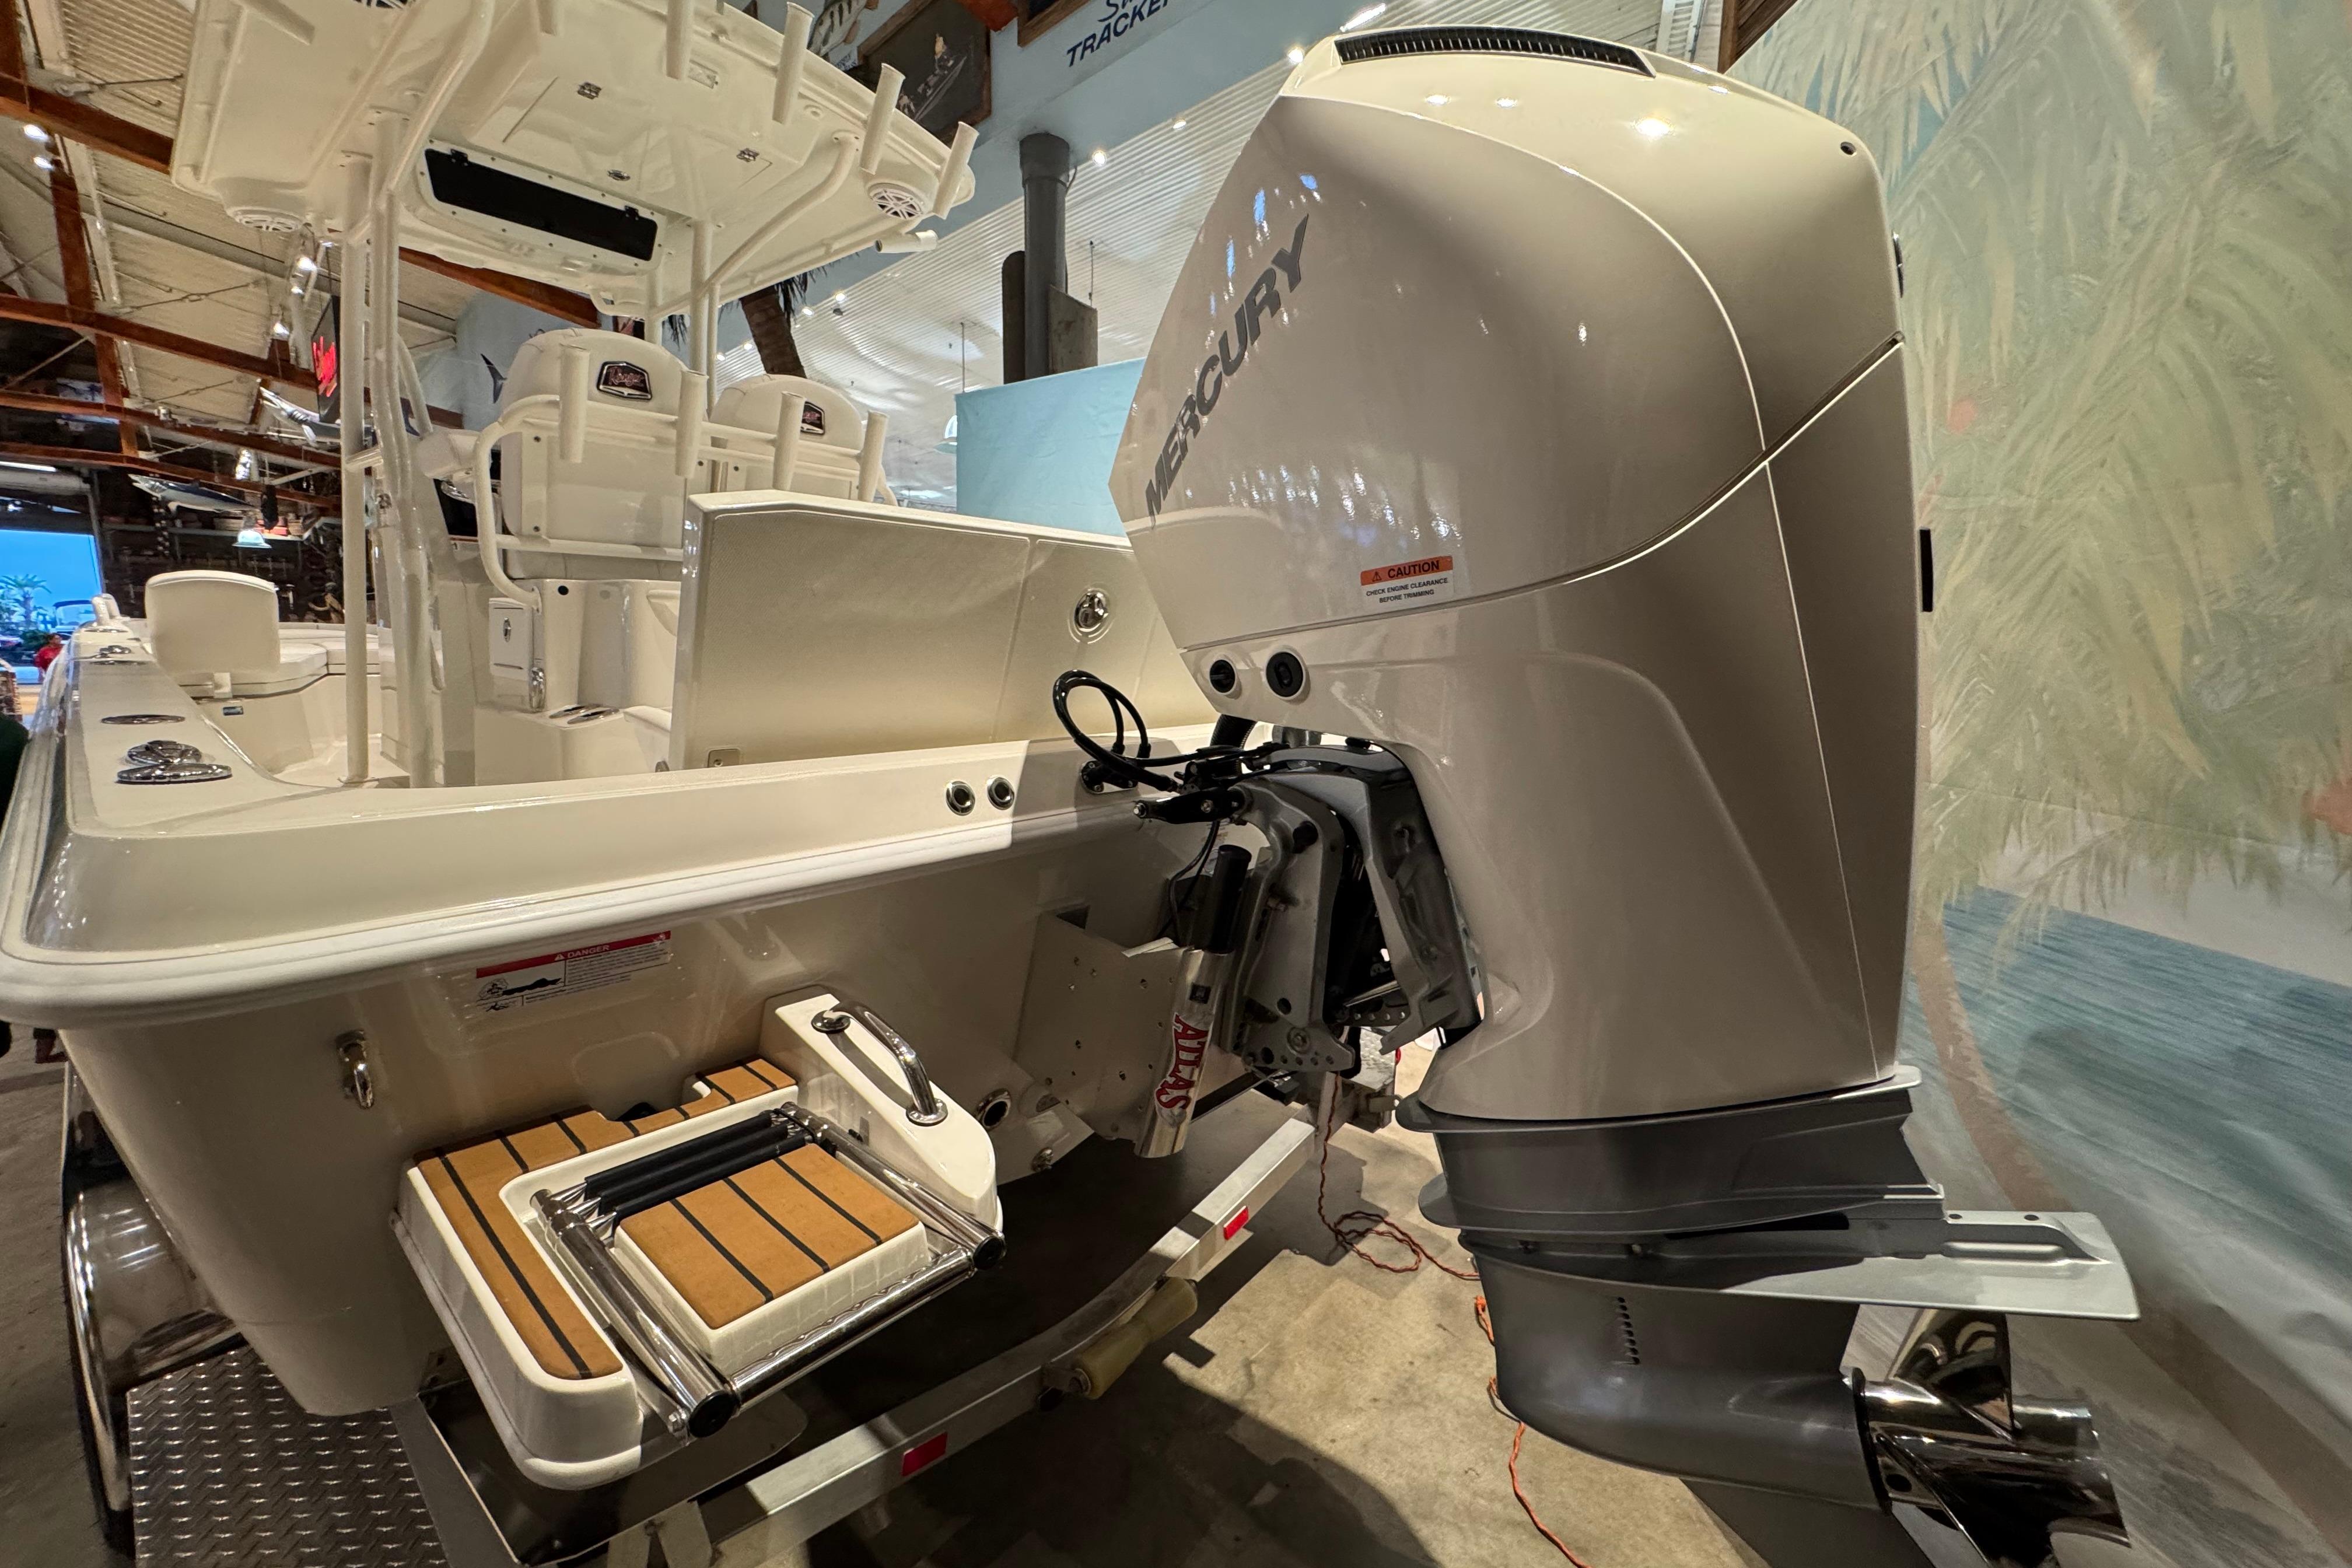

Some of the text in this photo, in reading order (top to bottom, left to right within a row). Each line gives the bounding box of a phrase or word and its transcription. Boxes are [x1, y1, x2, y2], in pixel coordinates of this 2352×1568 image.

[1067, 0, 1168, 67] TRACKE
[1145, 213, 1309, 528] MERCURY
[1388, 559, 1440, 578] CAUTION
[1387, 584, 1409, 593] ENGINE
[1410, 578, 1448, 589] CLEARANCE
[1379, 589, 1434, 603] BEFORE TRIMMING
[568, 945, 610, 958] DANGER
[1154, 1013, 1210, 1110] ATLAS
